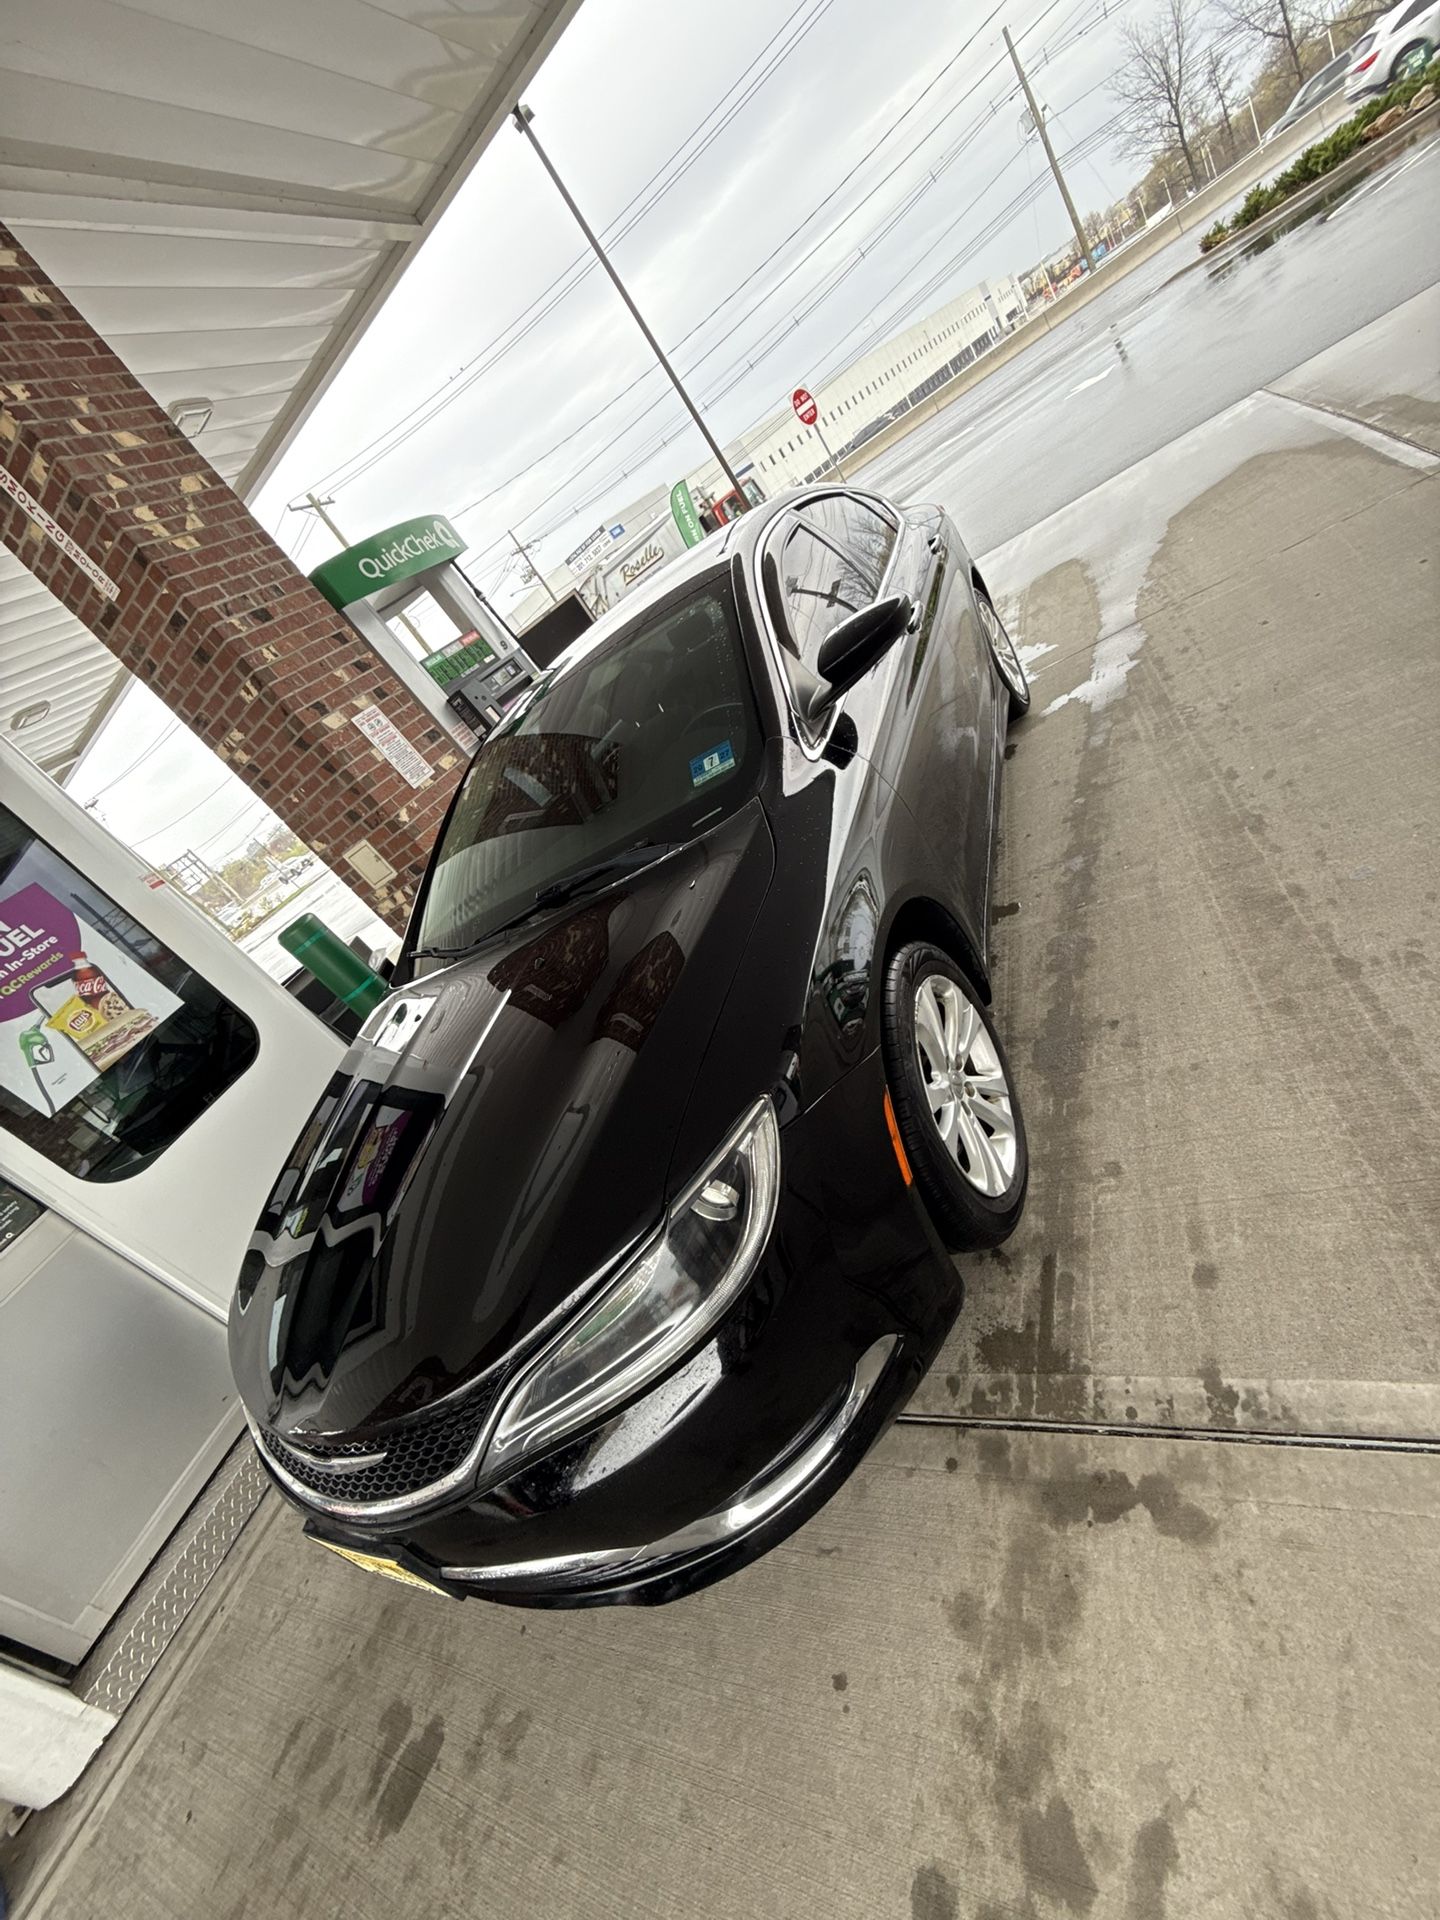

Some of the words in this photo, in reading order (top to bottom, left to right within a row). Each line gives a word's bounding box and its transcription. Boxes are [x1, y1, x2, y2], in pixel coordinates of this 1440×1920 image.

[802, 408, 815, 421] ENTER
[73, 550, 106, 584] MOTOR
[358, 529, 443, 578] QuickChek
[620, 544, 661, 582] Roselle
[500, 640, 508, 650] 9
[4, 936, 58, 972] In-Store
[0, 952, 64, 995] QCRewards
